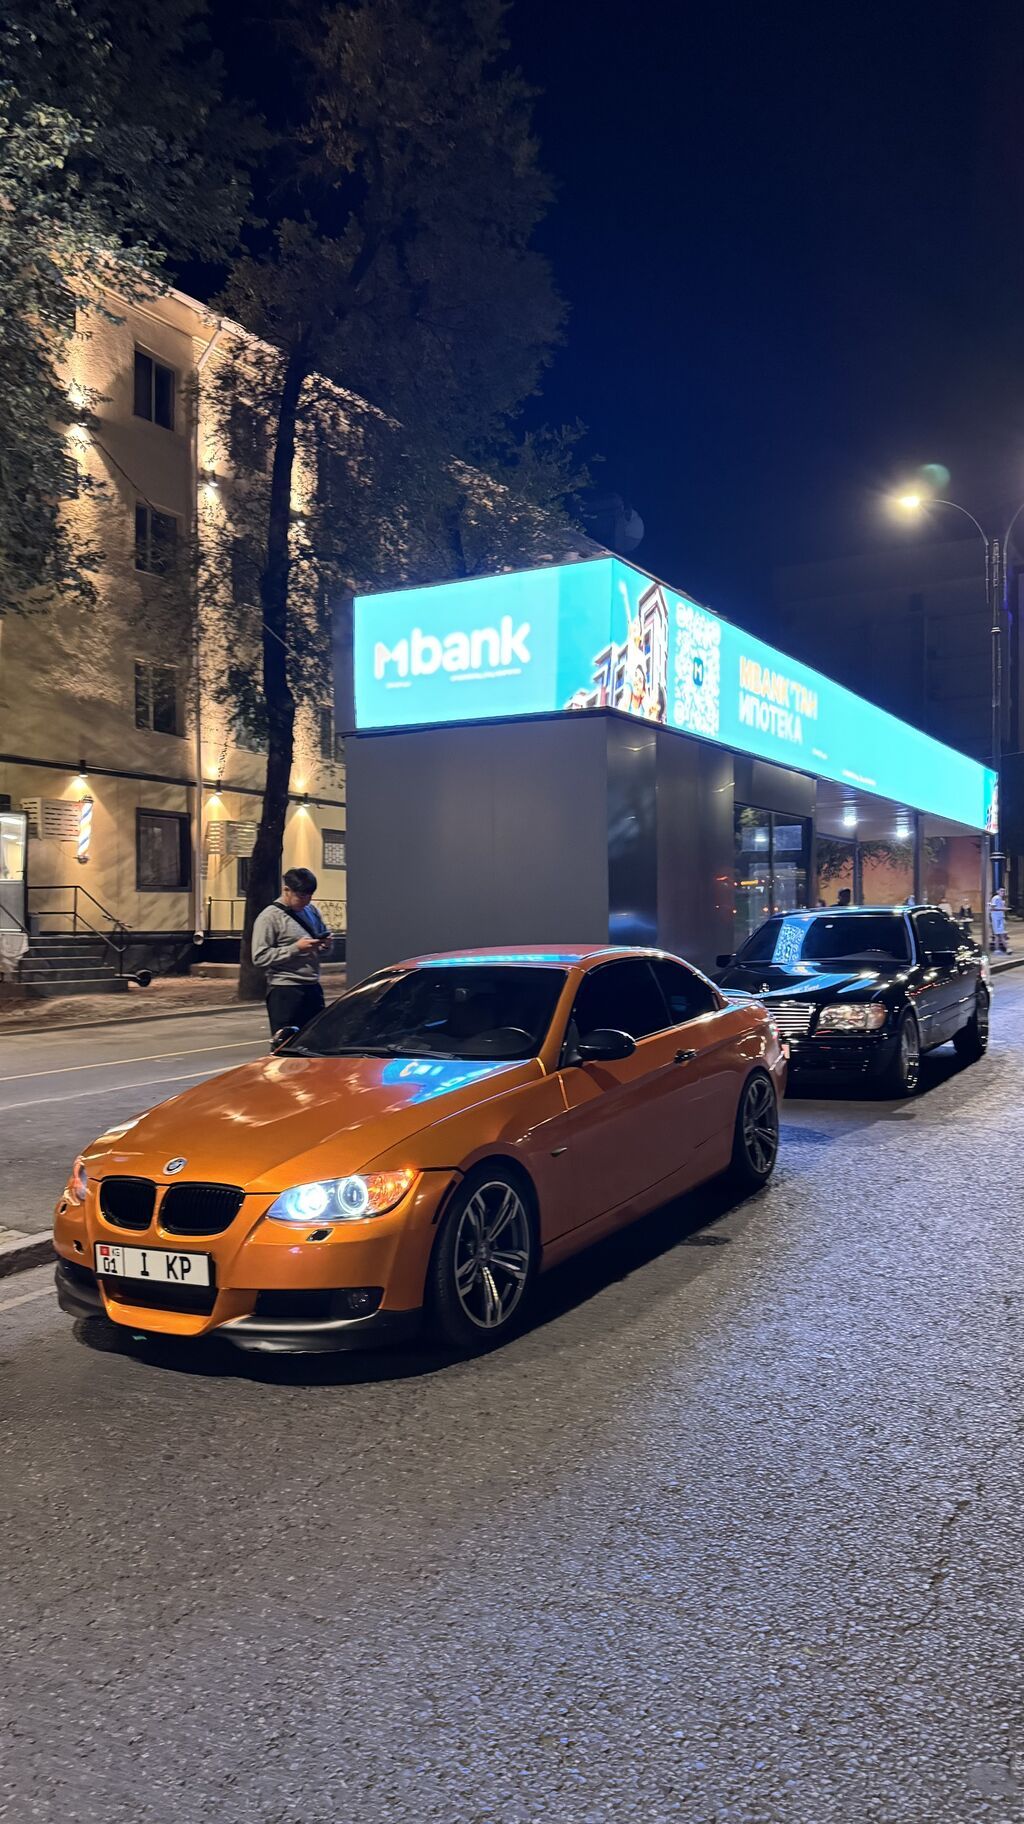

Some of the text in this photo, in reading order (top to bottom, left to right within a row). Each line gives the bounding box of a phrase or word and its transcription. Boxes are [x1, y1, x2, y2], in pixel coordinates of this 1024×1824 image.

[374, 614, 531, 680] Mbank
[738, 690, 803, 744] ИПОТЕКА
[103, 1257, 118, 1273] 01
[166, 1255, 191, 1280] KP
